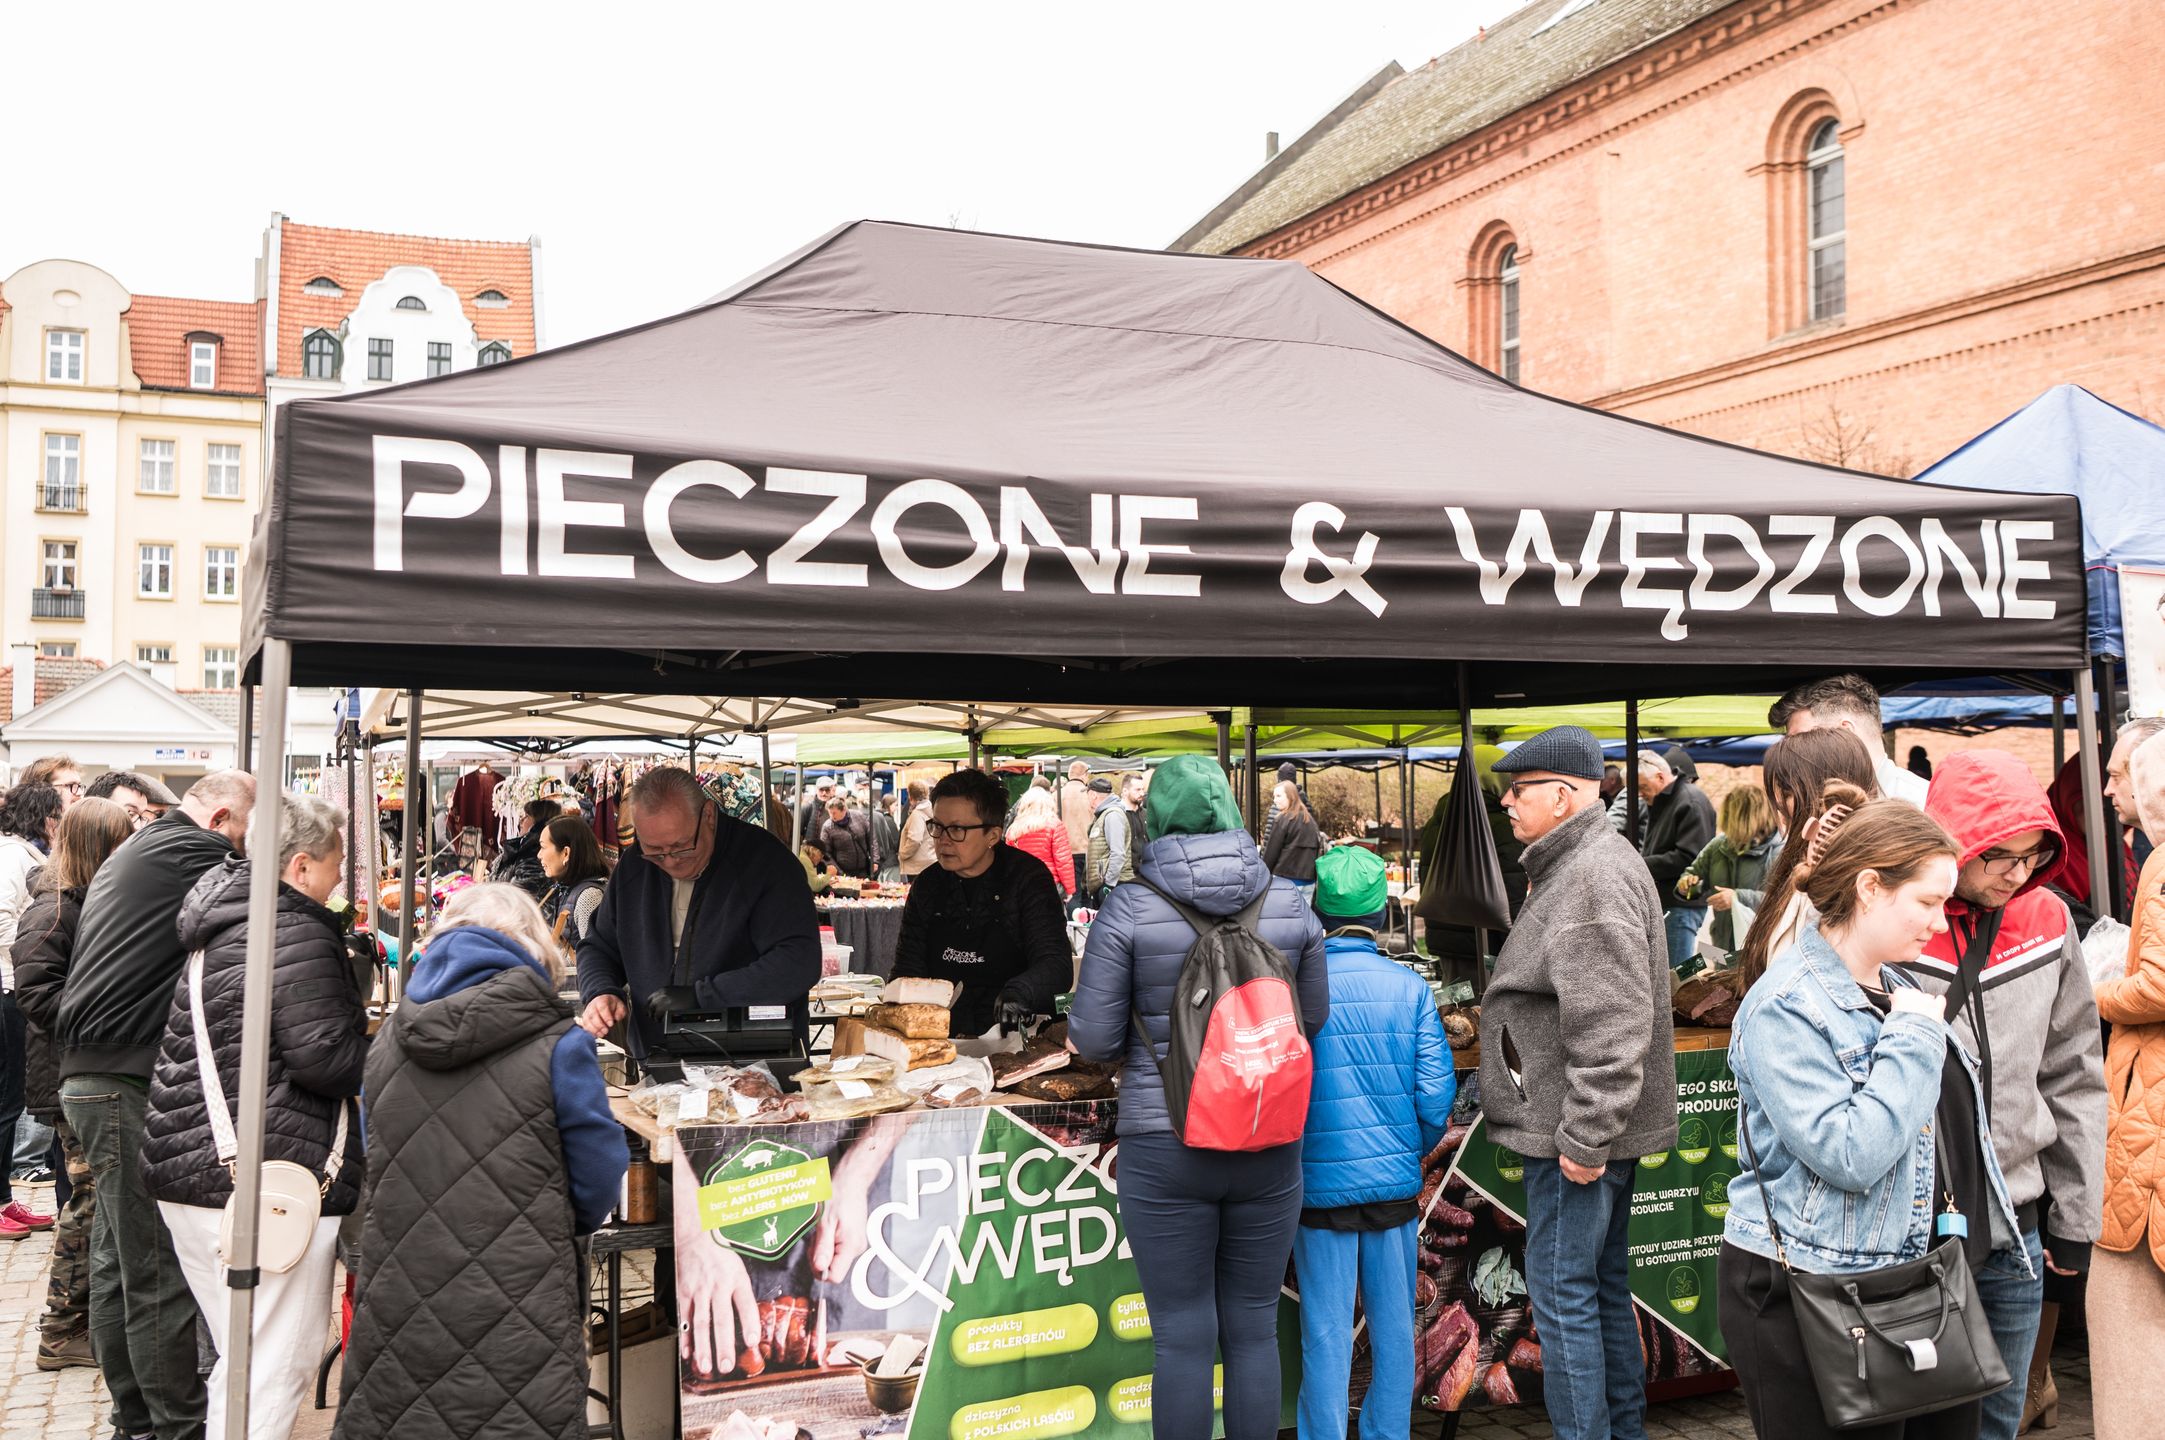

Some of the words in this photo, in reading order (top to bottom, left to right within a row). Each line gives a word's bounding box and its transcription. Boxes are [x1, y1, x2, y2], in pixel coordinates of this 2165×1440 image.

[373, 434, 1202, 597] PIECZONE
[1280, 501, 1388, 619] &
[1444, 506, 2056, 641] WĘDZONE
[1676, 1081, 1706, 1096] EGO
[1709, 1080, 1738, 1093] SKŁ
[1676, 1097, 1739, 1114] PRODUKC
[748, 1169, 797, 1189] GLUTENU
[1632, 1191, 1658, 1203] DZIAŁ
[1659, 1186, 1699, 1200] WARZYW
[1630, 1202, 1674, 1215] RODUKCIE
[937, 1203, 1134, 1287] WĘD
[1661, 1238, 1693, 1251] UDZIAŁ
[1635, 1258, 1644, 1267] W
[1645, 1251, 1692, 1265] GOTOWYM
[1693, 1247, 1720, 1259] PRODU
[1117, 1300, 1146, 1315] tylko
[967, 1319, 1023, 1339] produkty
[967, 1341, 990, 1353] BEZ
[993, 1328, 1066, 1350] ALERGENÓW
[964, 1404, 1022, 1424] dziczyzna
[1118, 1396, 1152, 1412] NATUR
[973, 1418, 1031, 1439] POLSKICH
[1033, 1408, 1076, 1427] LASÓW
